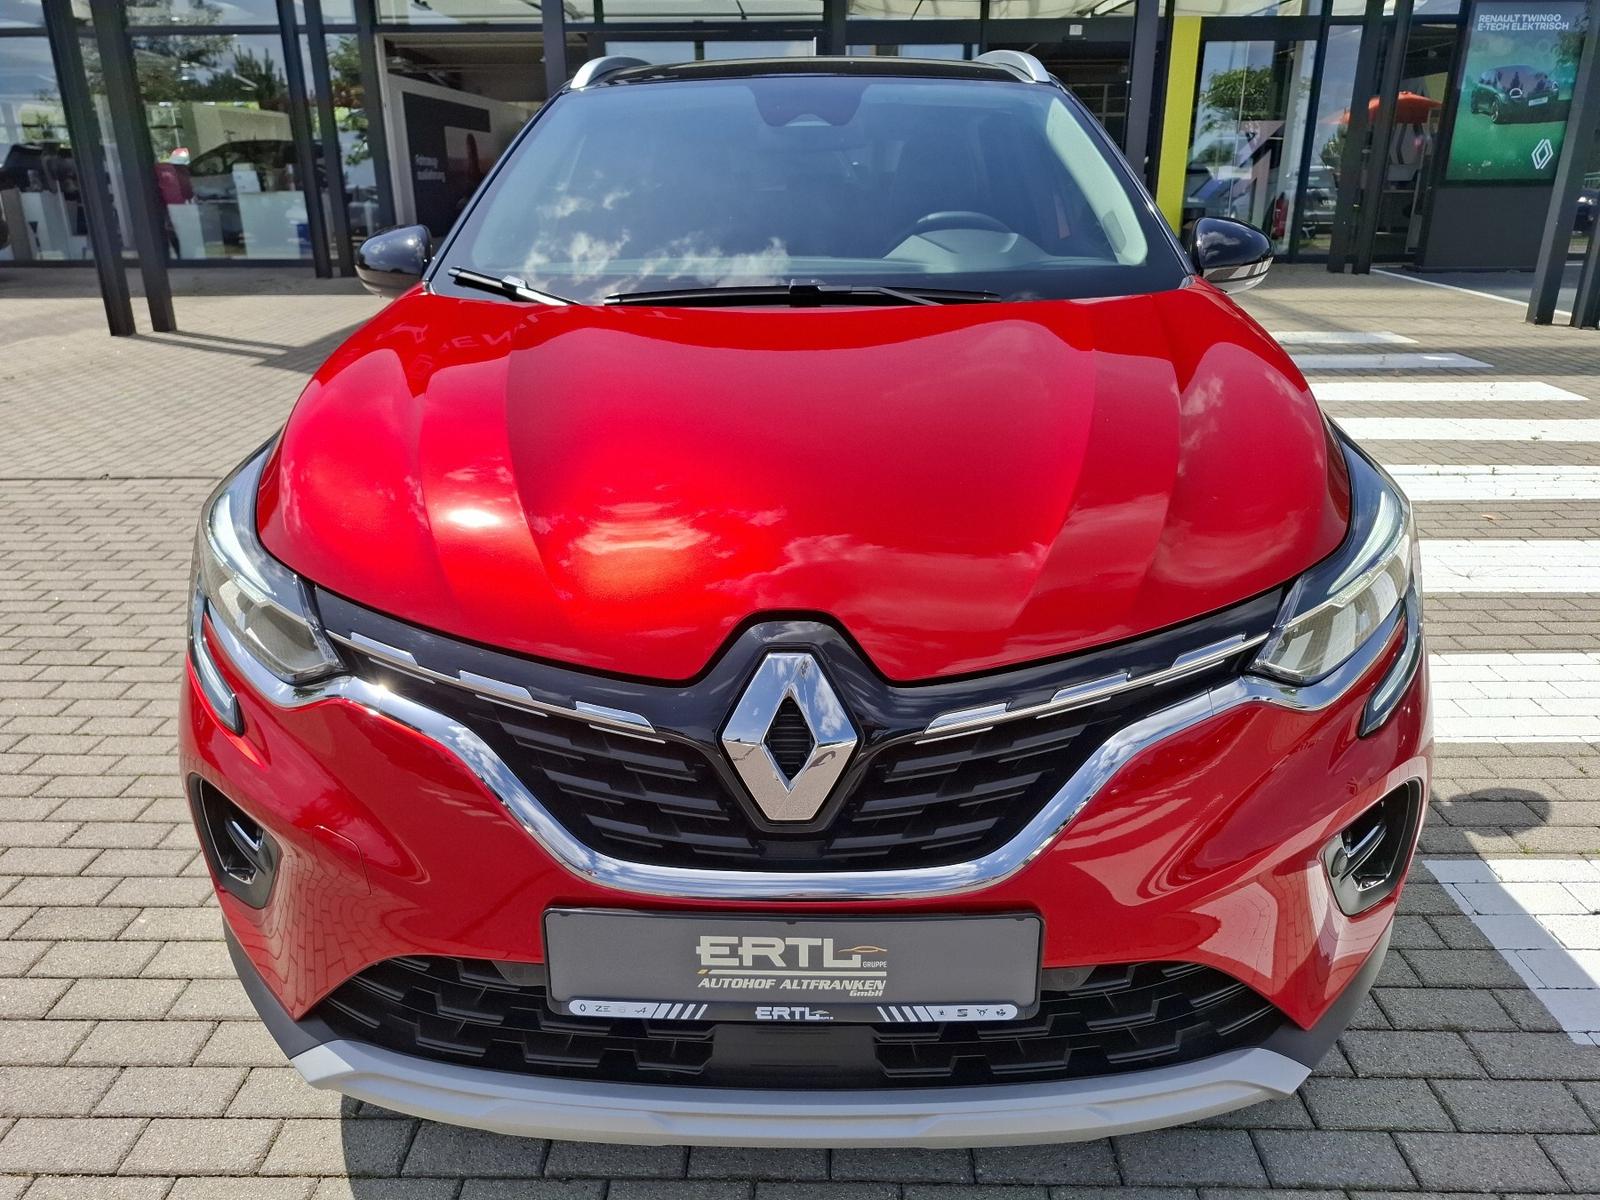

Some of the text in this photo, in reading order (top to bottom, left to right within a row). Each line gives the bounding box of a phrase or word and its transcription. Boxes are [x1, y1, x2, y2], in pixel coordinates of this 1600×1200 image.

[1479, 13, 1562, 22] RENAULT TWINGO
[1477, 22, 1569, 31] E-TECH ELEKTRISCH
[696, 936, 887, 968] ERTL GRUPPE
[698, 978, 886, 990] AUTOHOF ALTFRANKEN
[849, 989, 883, 997] GmbH
[755, 1006, 820, 1020] ERTL
